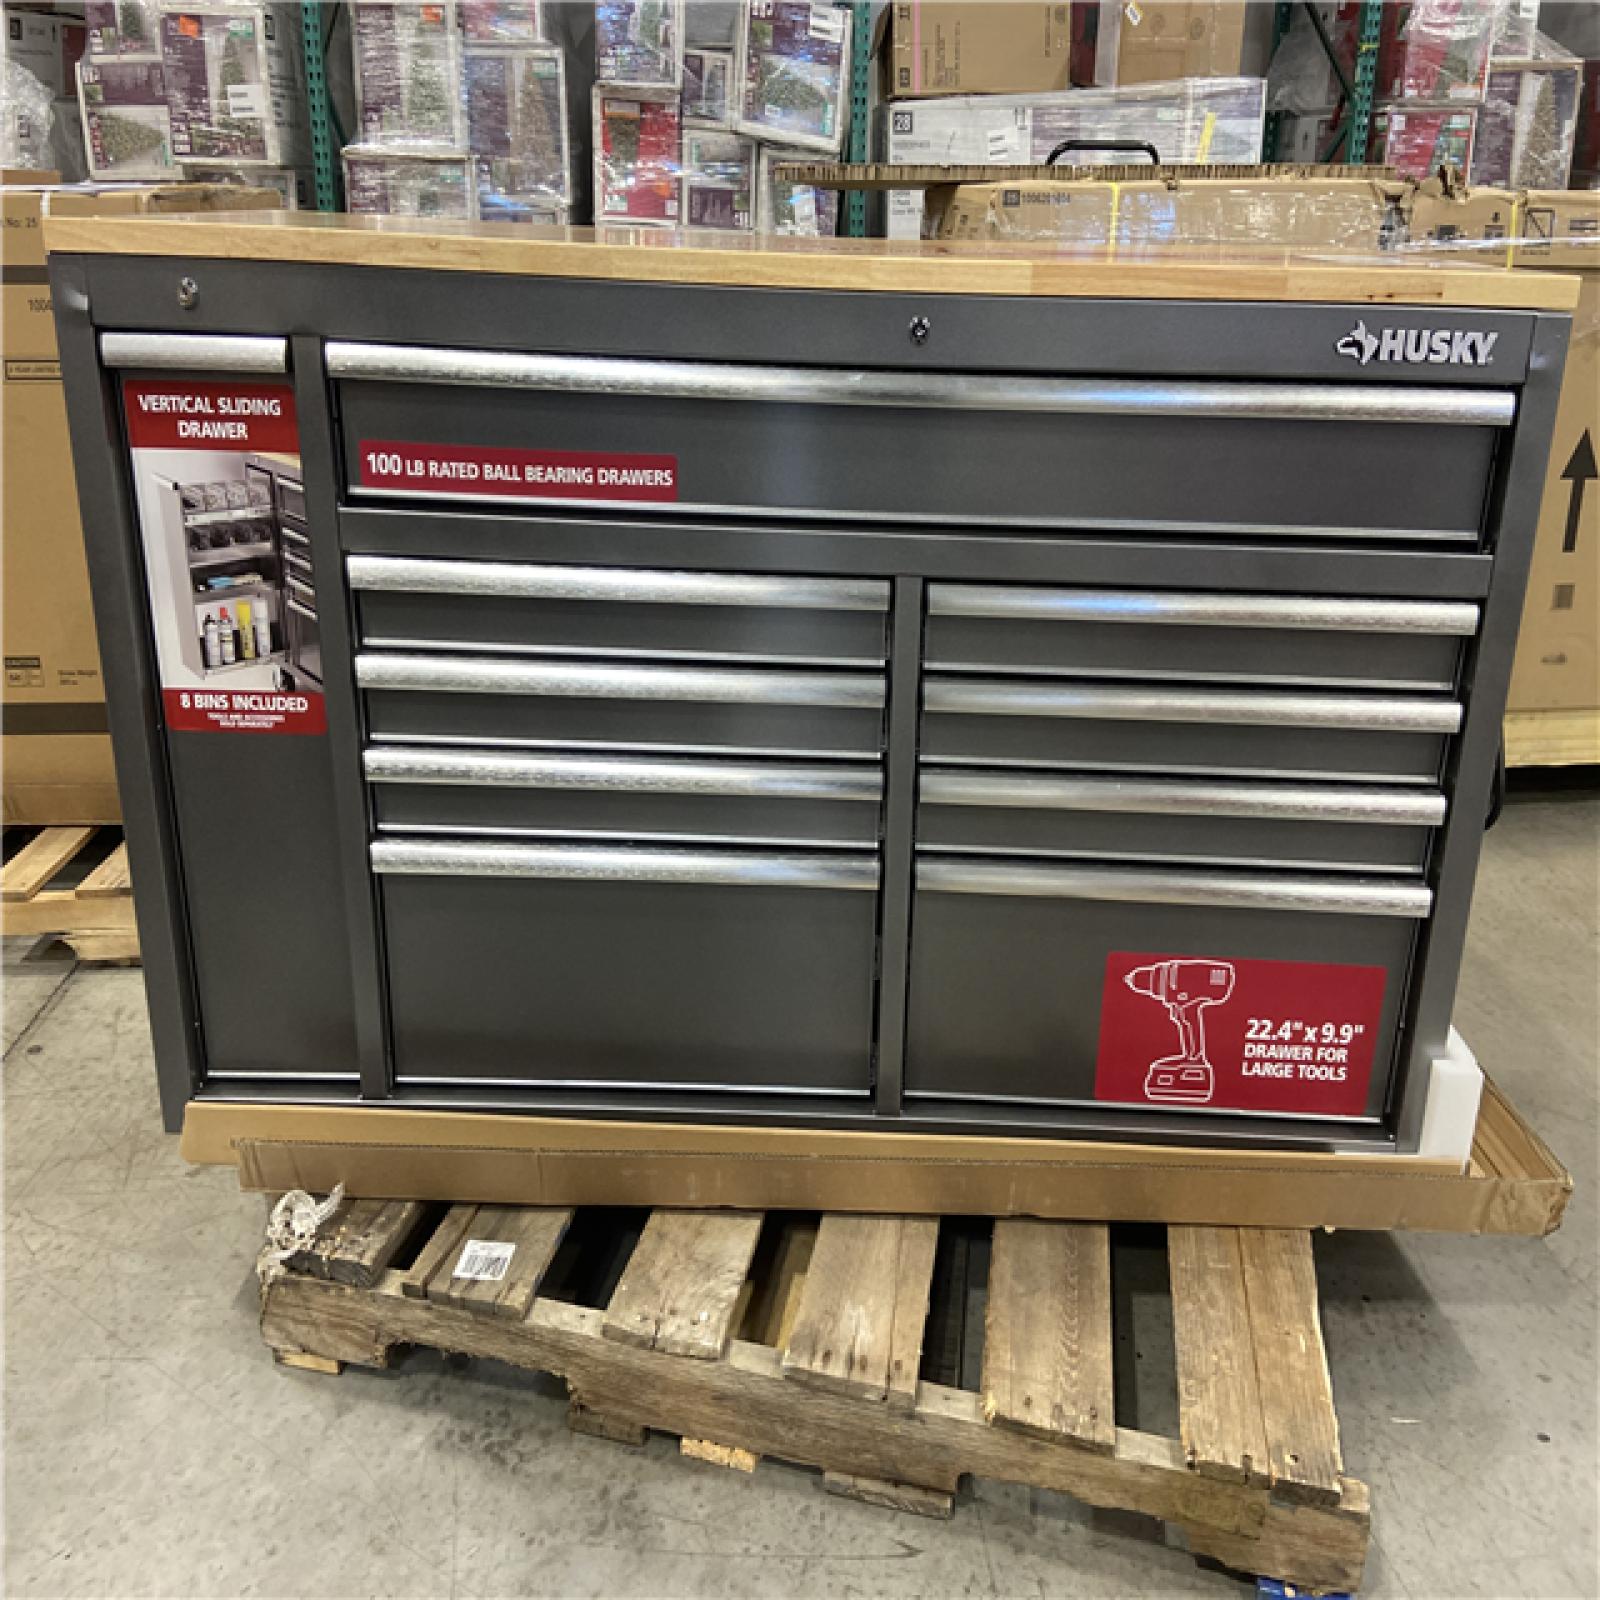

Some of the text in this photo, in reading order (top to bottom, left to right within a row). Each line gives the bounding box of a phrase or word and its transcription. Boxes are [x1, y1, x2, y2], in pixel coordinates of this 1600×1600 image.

[1380, 329, 1499, 365] HUSKY
[137, 394, 281, 416] VERTICAL SLIDING
[177, 420, 248, 440] DRAWER
[367, 452, 673, 486] 100 LB RATED BALL BEARING DRAWERS
[180, 693, 308, 712] 8 BINS INCLUDED
[1245, 1018, 1365, 1044] 22.4" x 9.9"
[1244, 1042, 1348, 1063] DRAWER FOR
[1241, 1061, 1347, 1081] LARGE TOOLS
